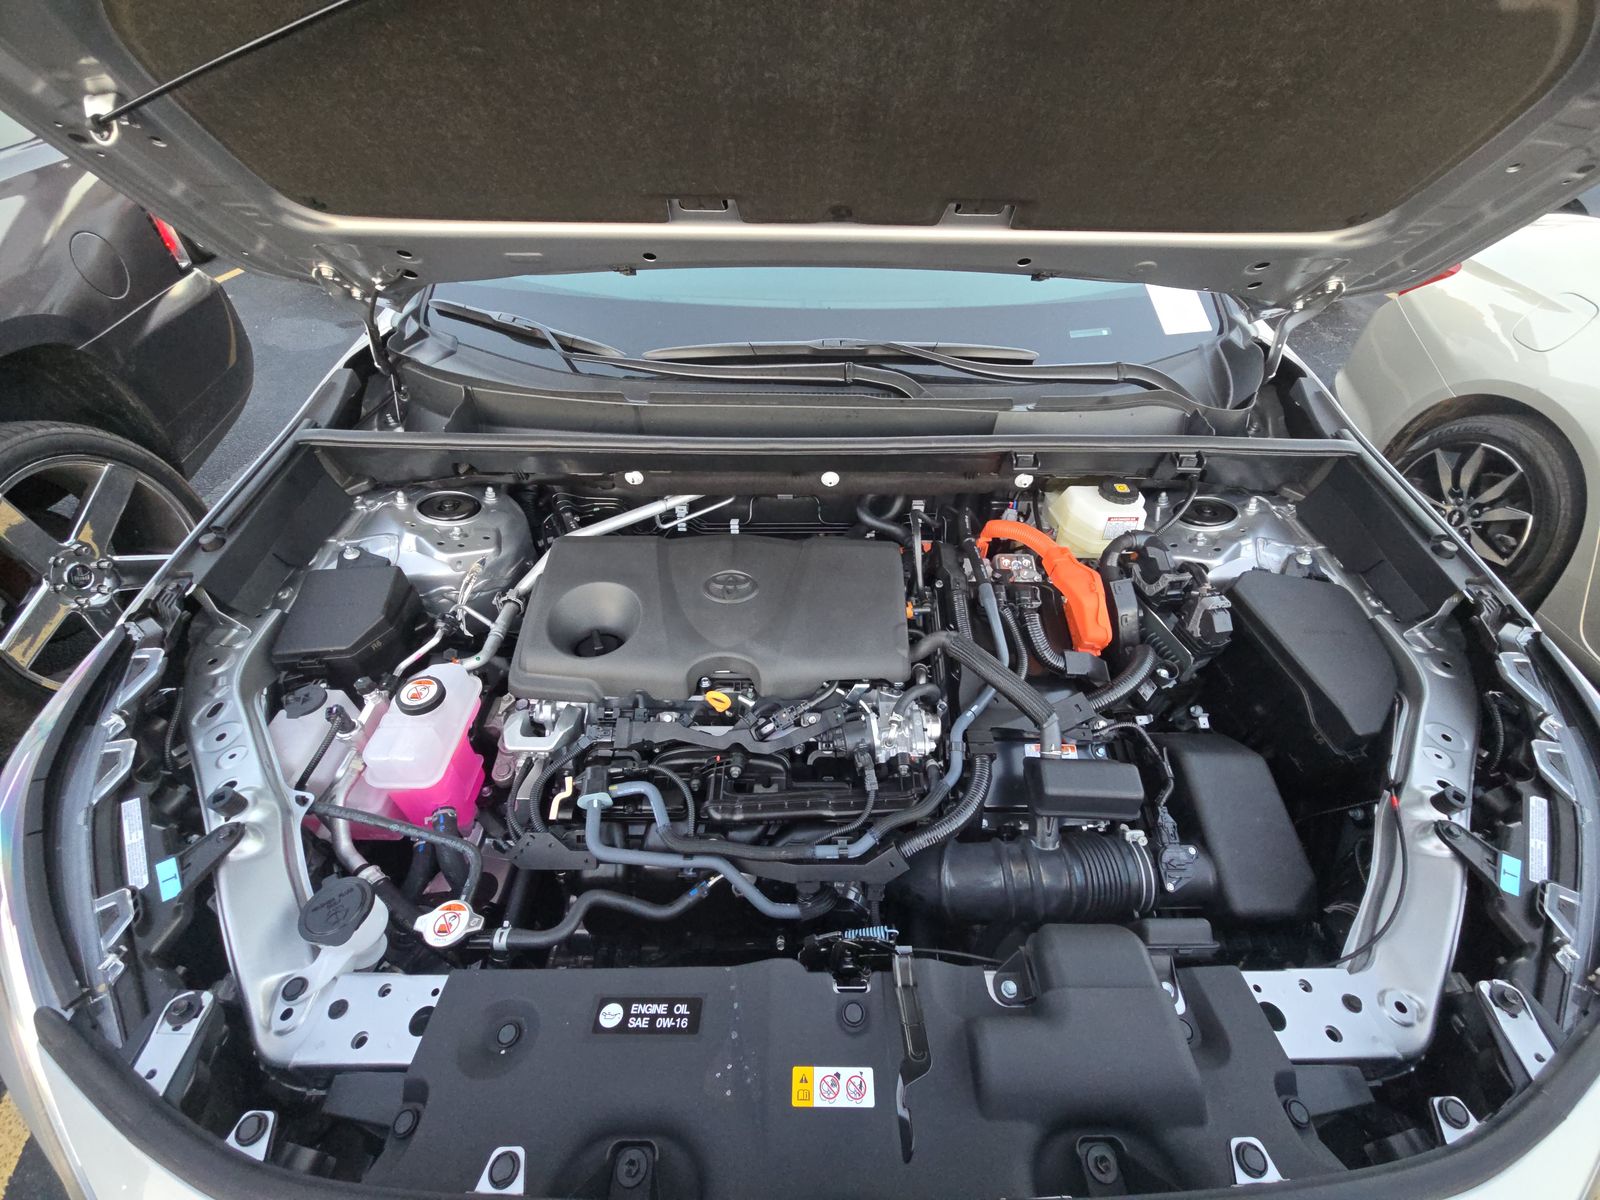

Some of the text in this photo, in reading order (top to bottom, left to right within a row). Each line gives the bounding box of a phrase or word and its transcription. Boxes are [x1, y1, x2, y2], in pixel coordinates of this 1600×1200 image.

[630, 1003, 691, 1015] ENGINE OIL
[627, 1017, 689, 1029] SAE 0W-16
